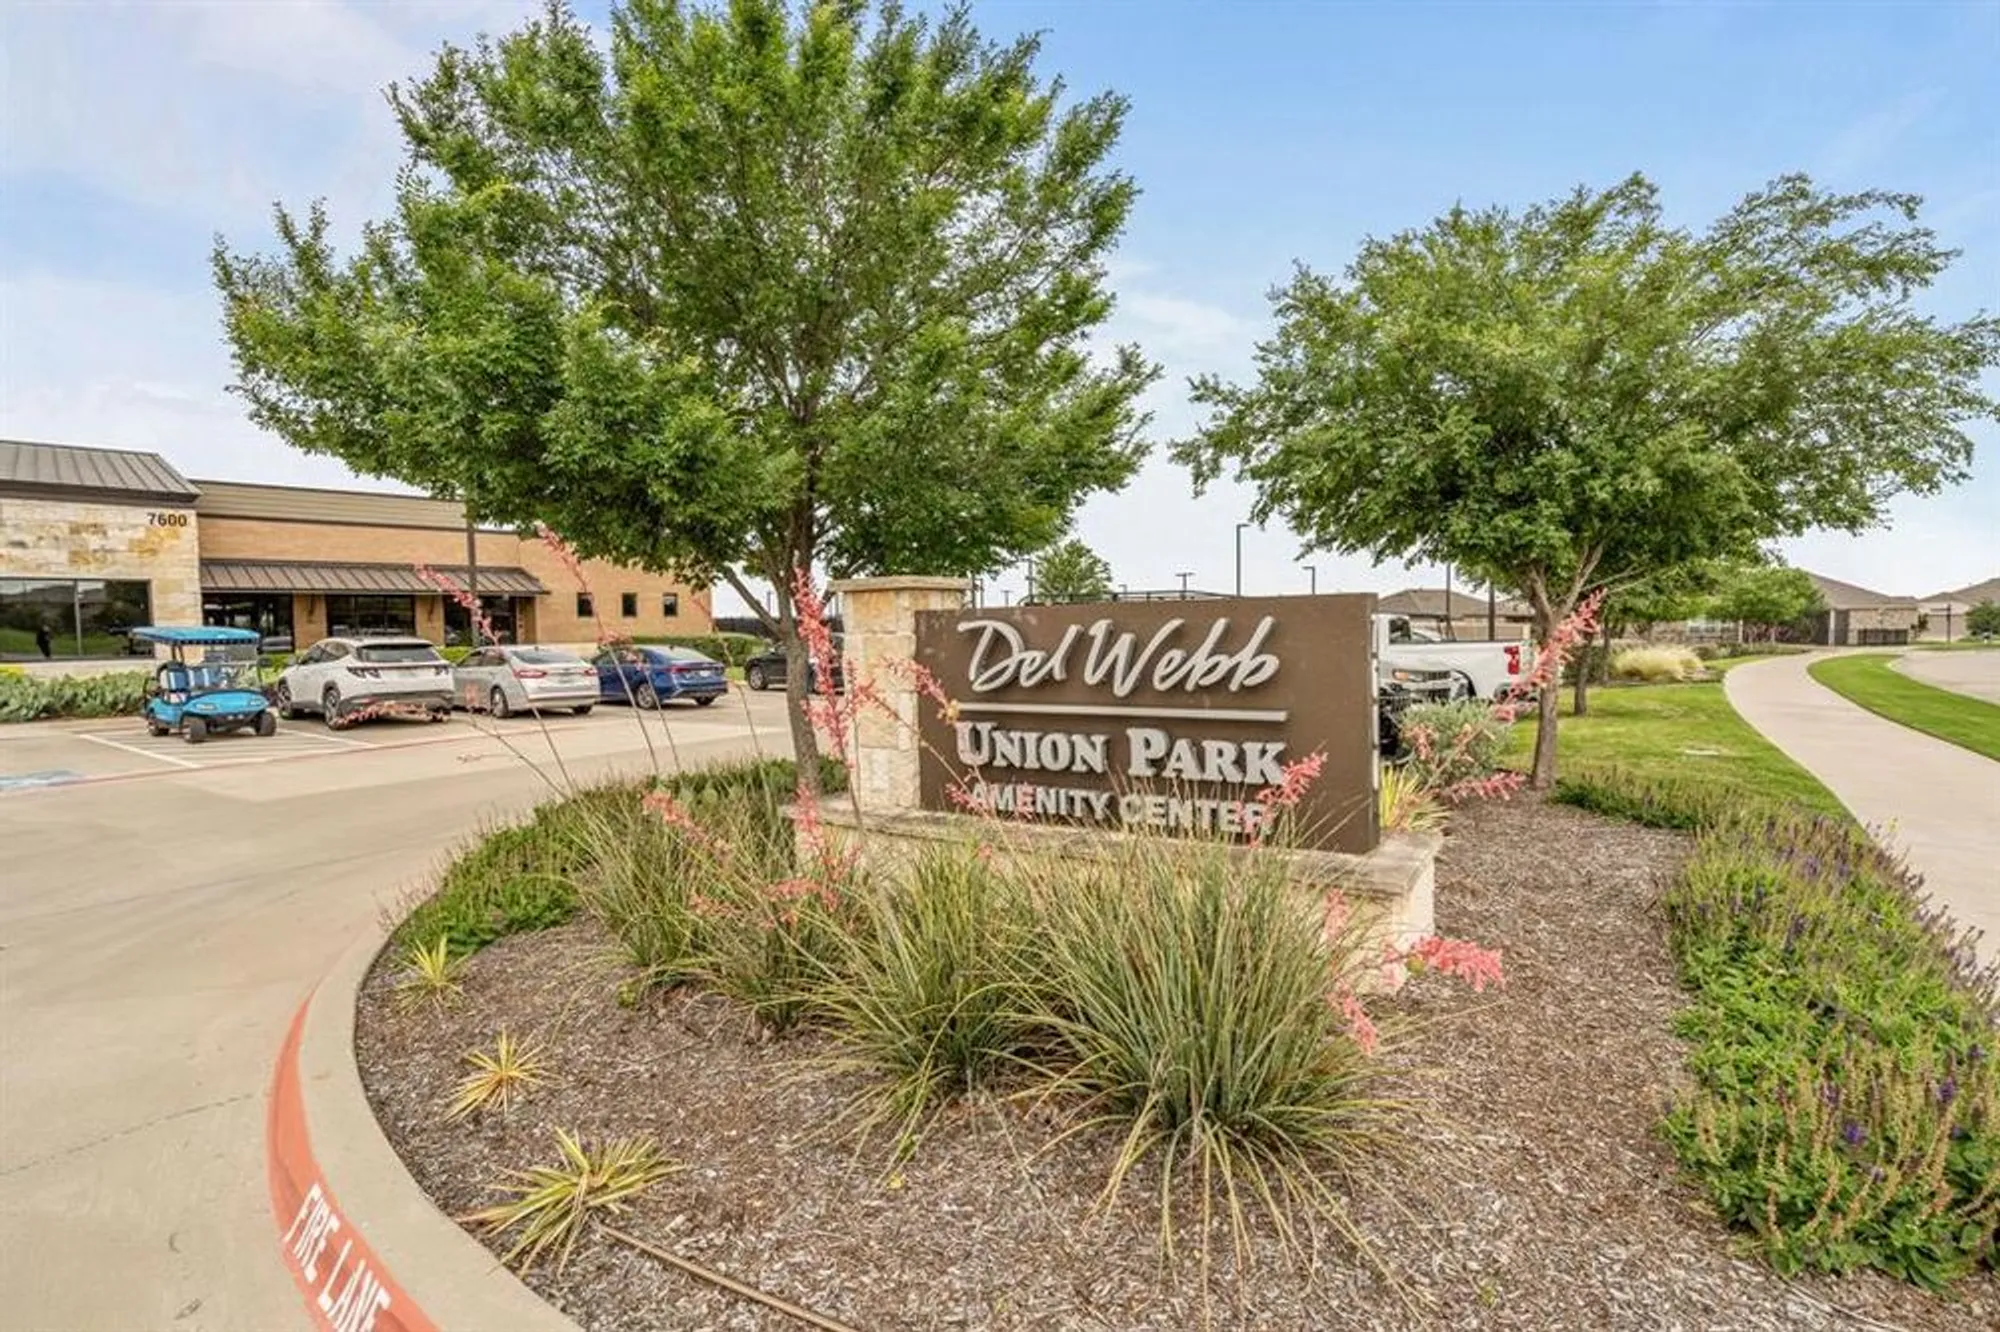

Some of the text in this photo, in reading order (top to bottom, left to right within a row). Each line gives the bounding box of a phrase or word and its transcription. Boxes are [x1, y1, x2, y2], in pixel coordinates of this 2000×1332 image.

[147, 512, 187, 527] 7600
[957, 615, 1280, 698] Del Webb
[955, 720, 1287, 786] UNION PARK
[971, 782, 1115, 820] AMENITY
[283, 1183, 392, 1332] FIRE LANE
